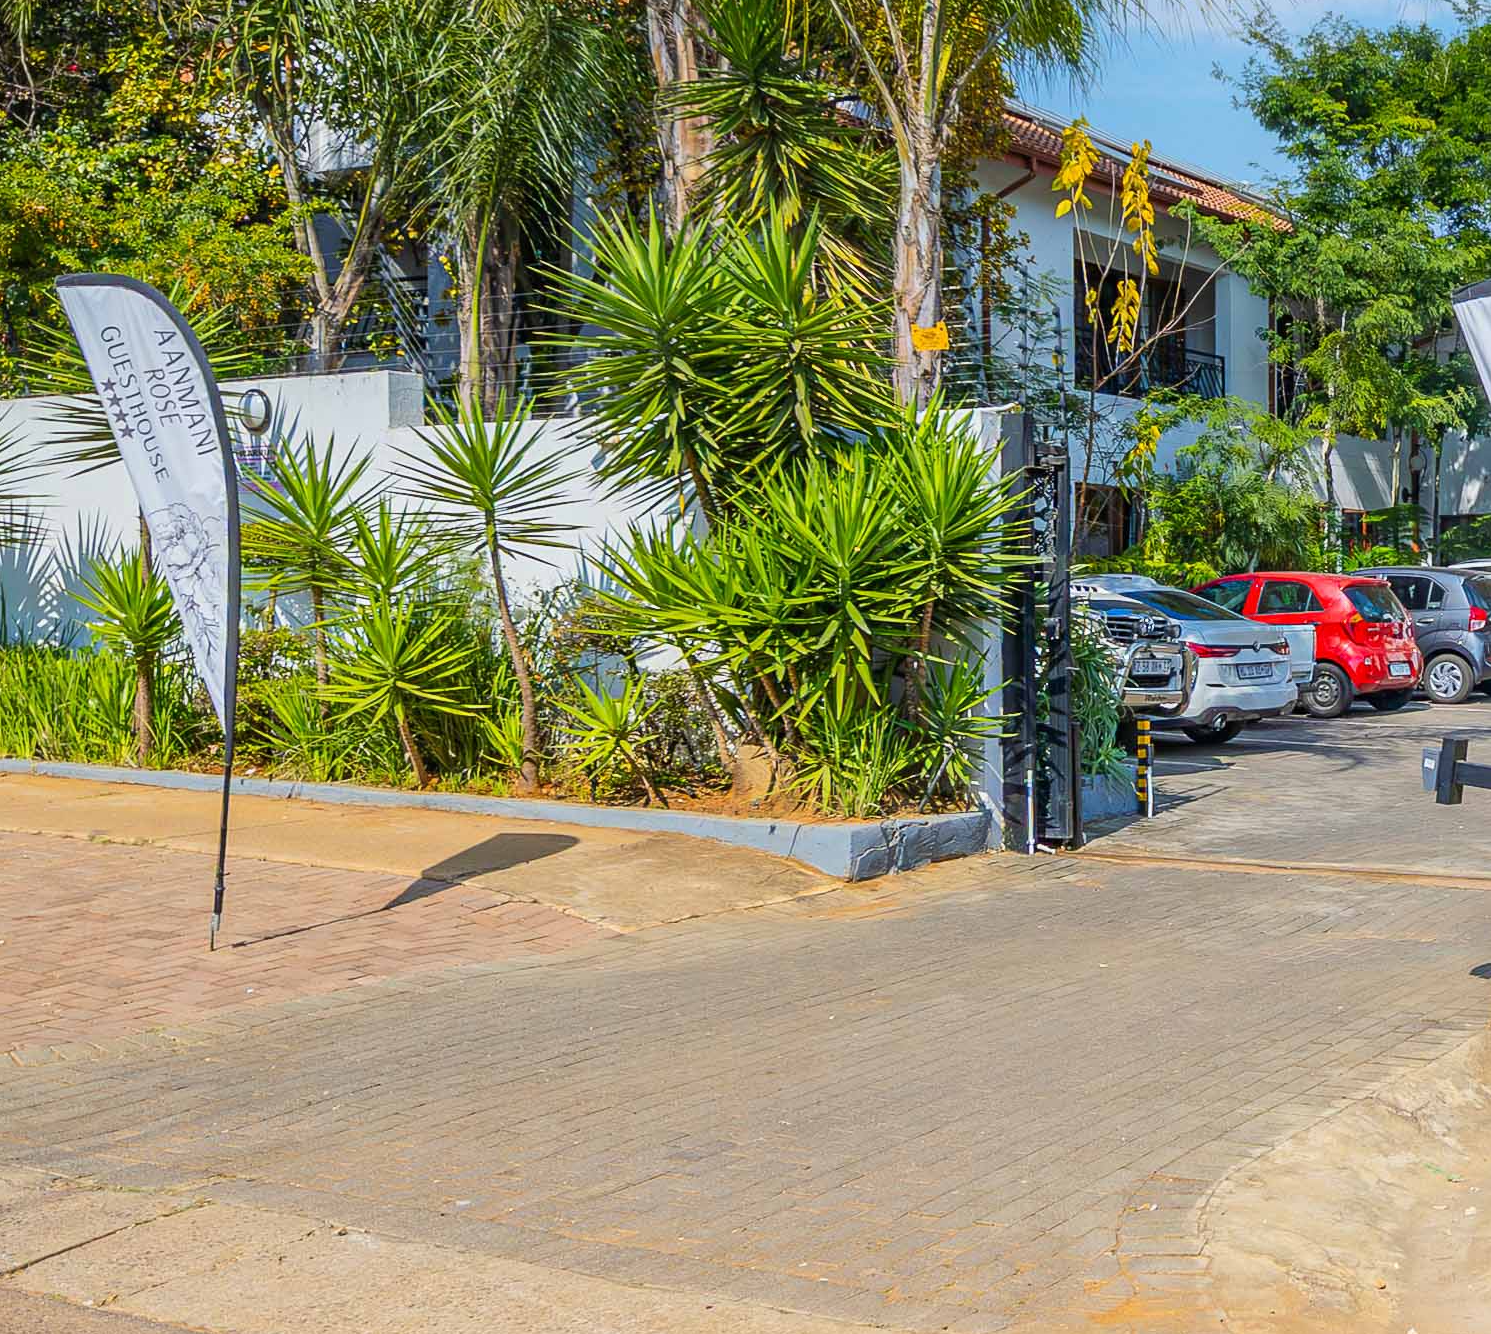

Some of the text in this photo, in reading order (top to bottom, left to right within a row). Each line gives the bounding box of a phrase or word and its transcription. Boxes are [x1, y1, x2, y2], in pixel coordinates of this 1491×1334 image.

[100, 326, 170, 484] GUESTHOUSE
[143, 368, 183, 428] ROSE
[153, 330, 218, 456] AANMANI
